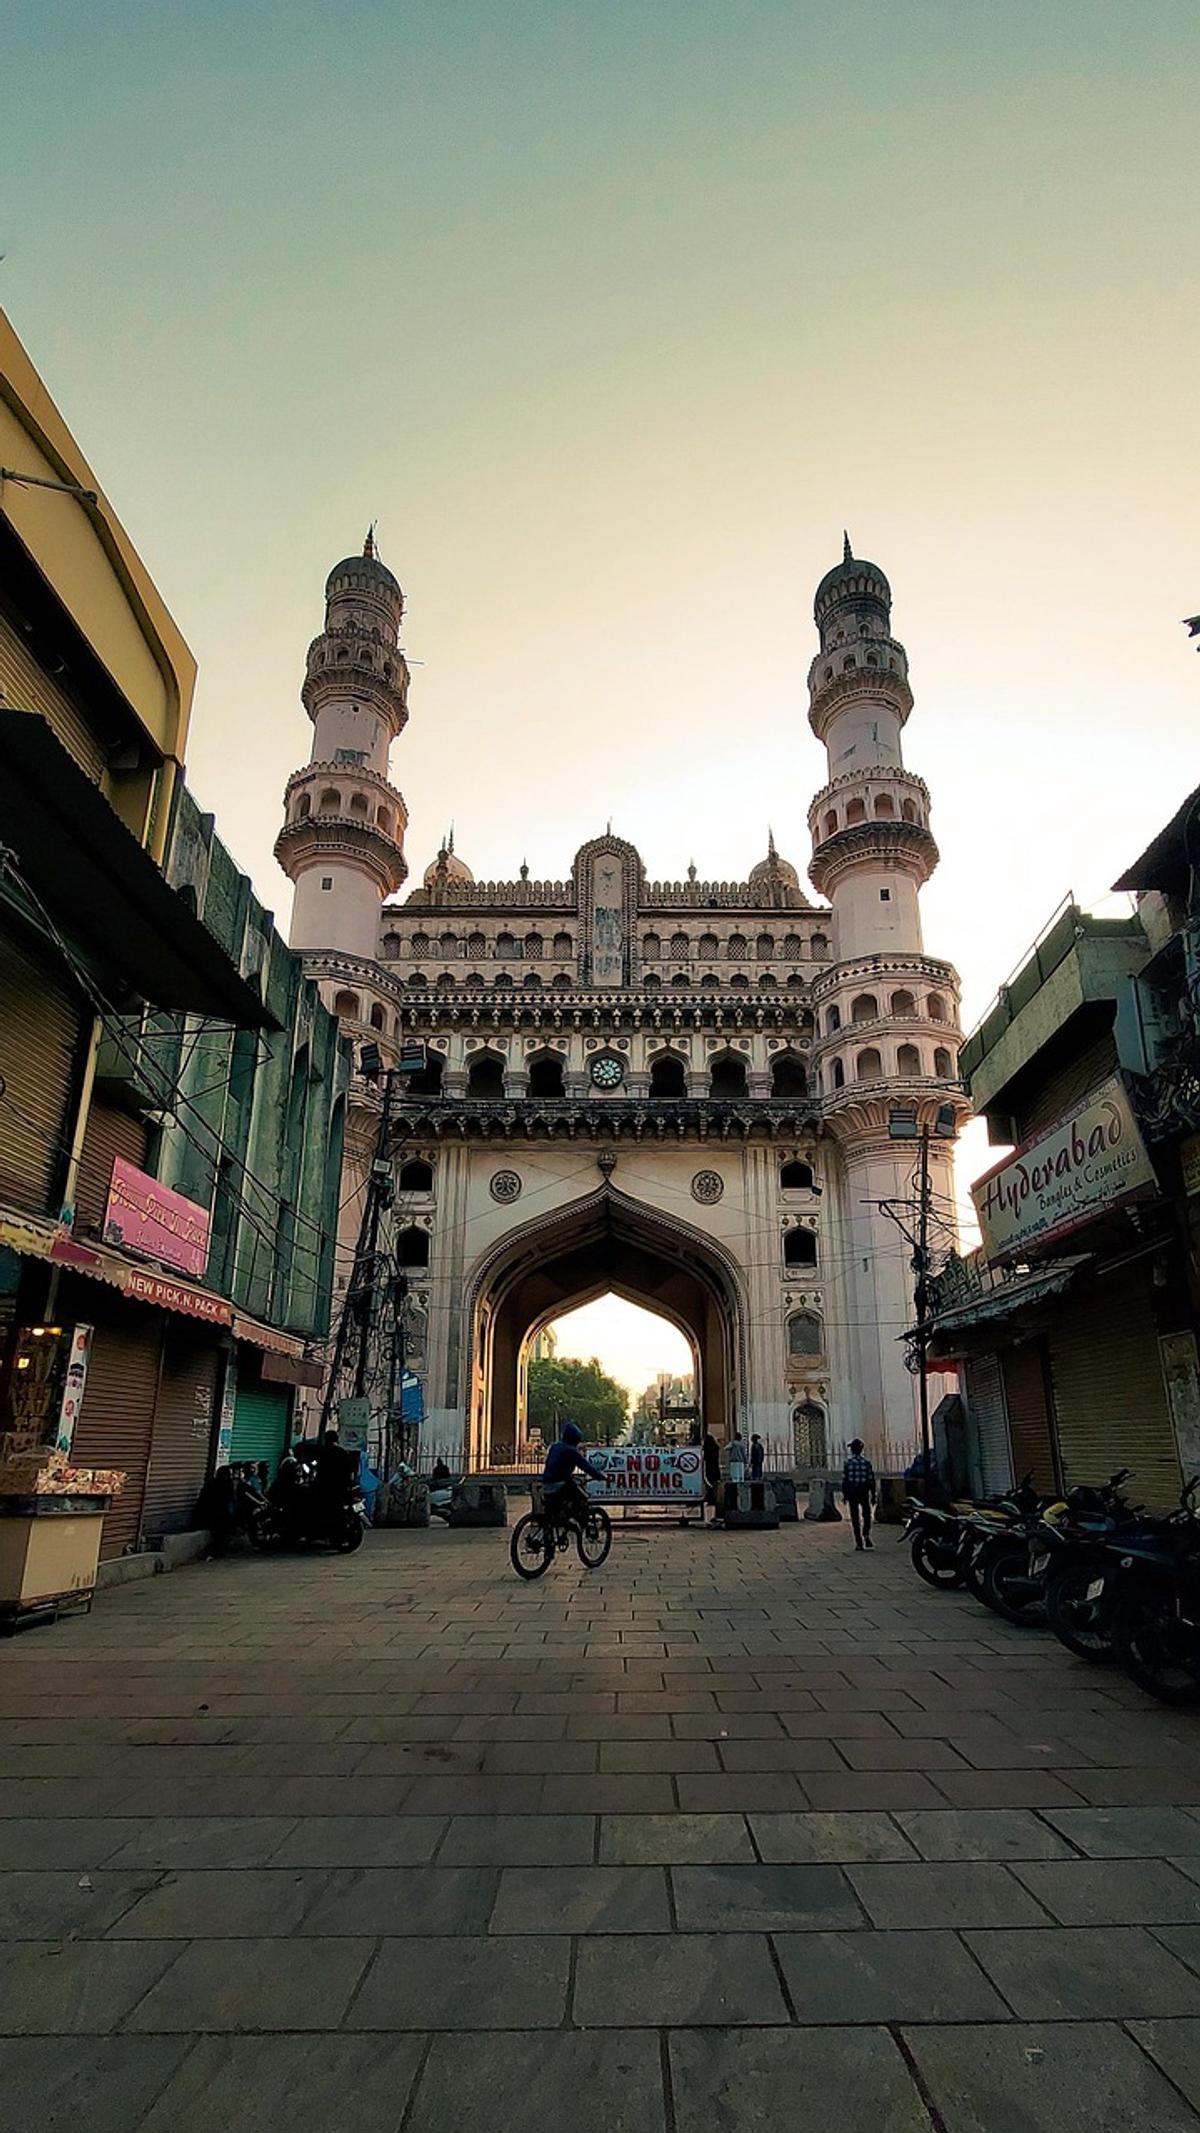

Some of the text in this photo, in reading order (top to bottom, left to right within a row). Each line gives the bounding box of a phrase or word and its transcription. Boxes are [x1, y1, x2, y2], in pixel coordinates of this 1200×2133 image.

[981, 1101, 1122, 1220] Hyderabad
[1037, 1185, 1073, 1211] Bangles
[1074, 1178, 1083, 1192] &
[1084, 1150, 1137, 1184] Cosmetics
[128, 1276, 155, 1296] NEW
[194, 1298, 218, 1316] PACK
[606, 1473, 683, 1489] PARKING
[627, 1455, 661, 1472] NO
